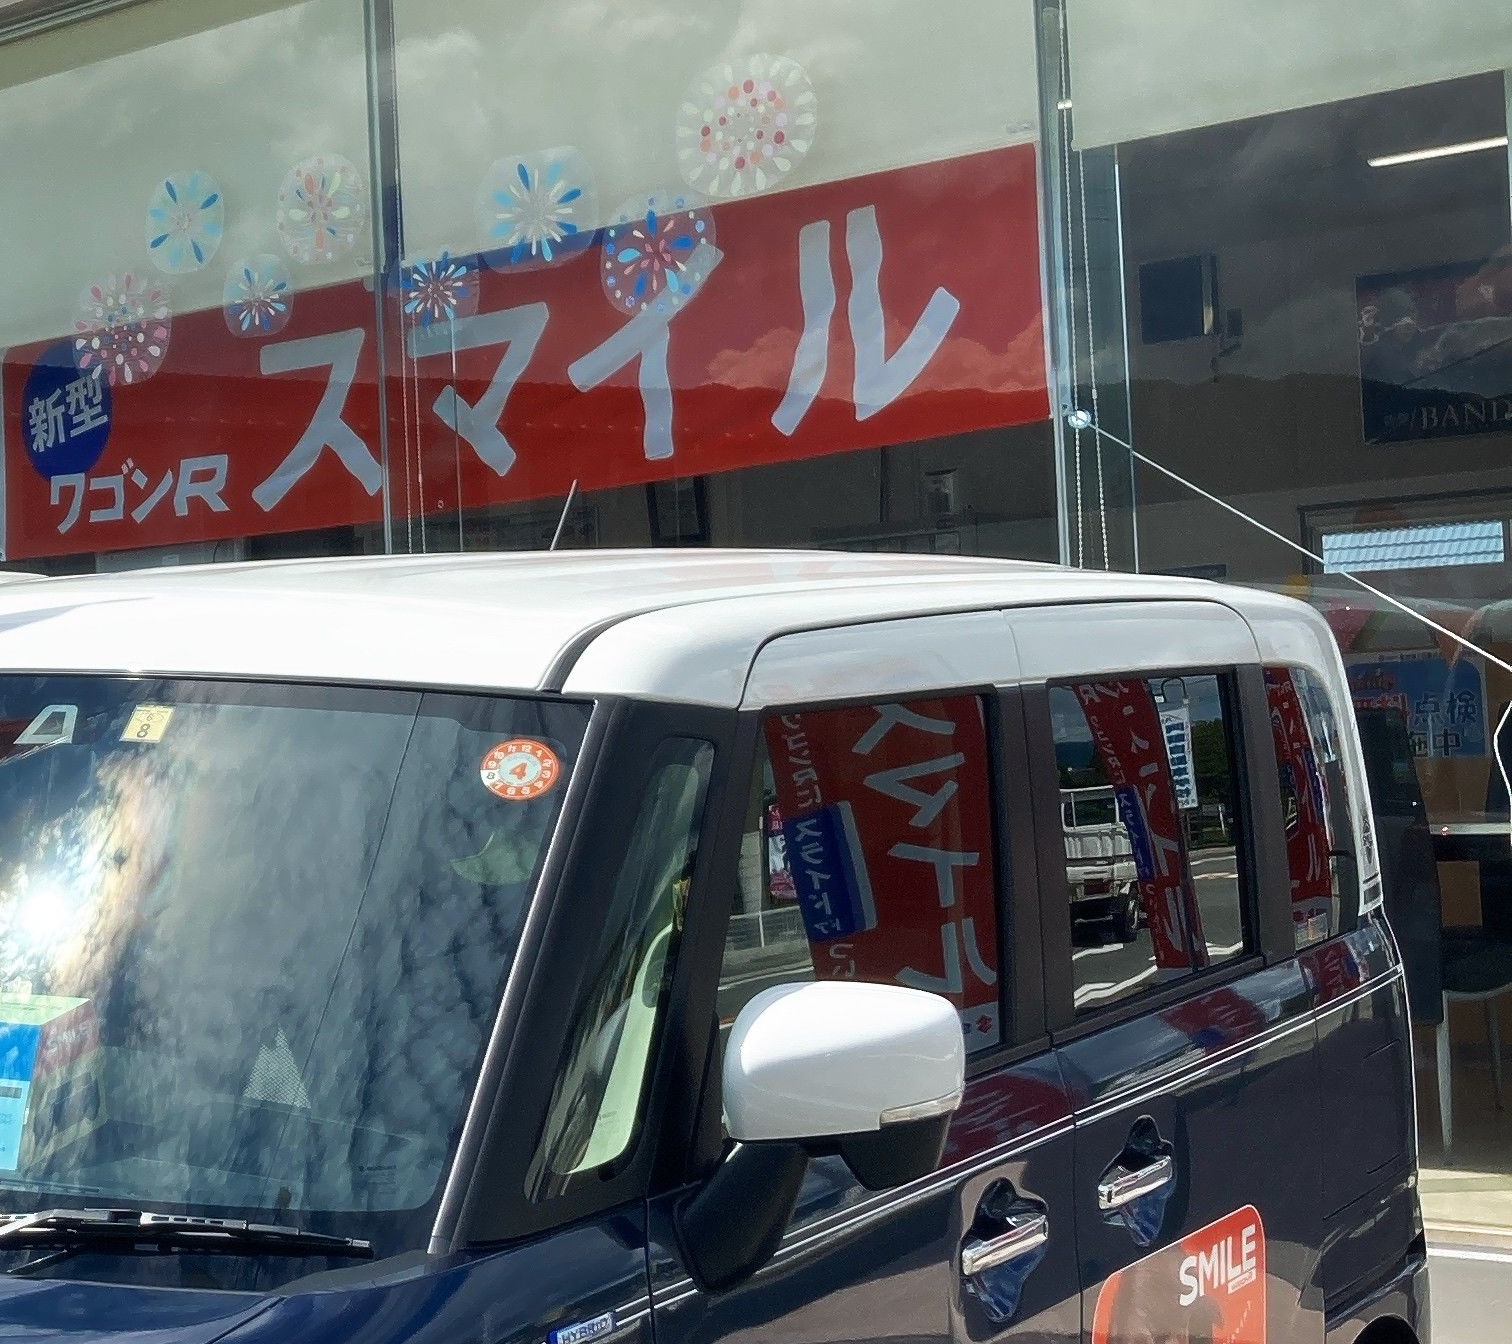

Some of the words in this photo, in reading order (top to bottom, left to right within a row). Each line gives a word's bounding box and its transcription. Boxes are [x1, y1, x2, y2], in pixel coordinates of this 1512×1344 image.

[251, 204, 961, 512] スマイル
[28, 361, 108, 454] 新型
[49, 449, 228, 535] ワゴンR
[136, 723, 151, 738] 8
[1179, 1223, 1257, 1307] SMILE
